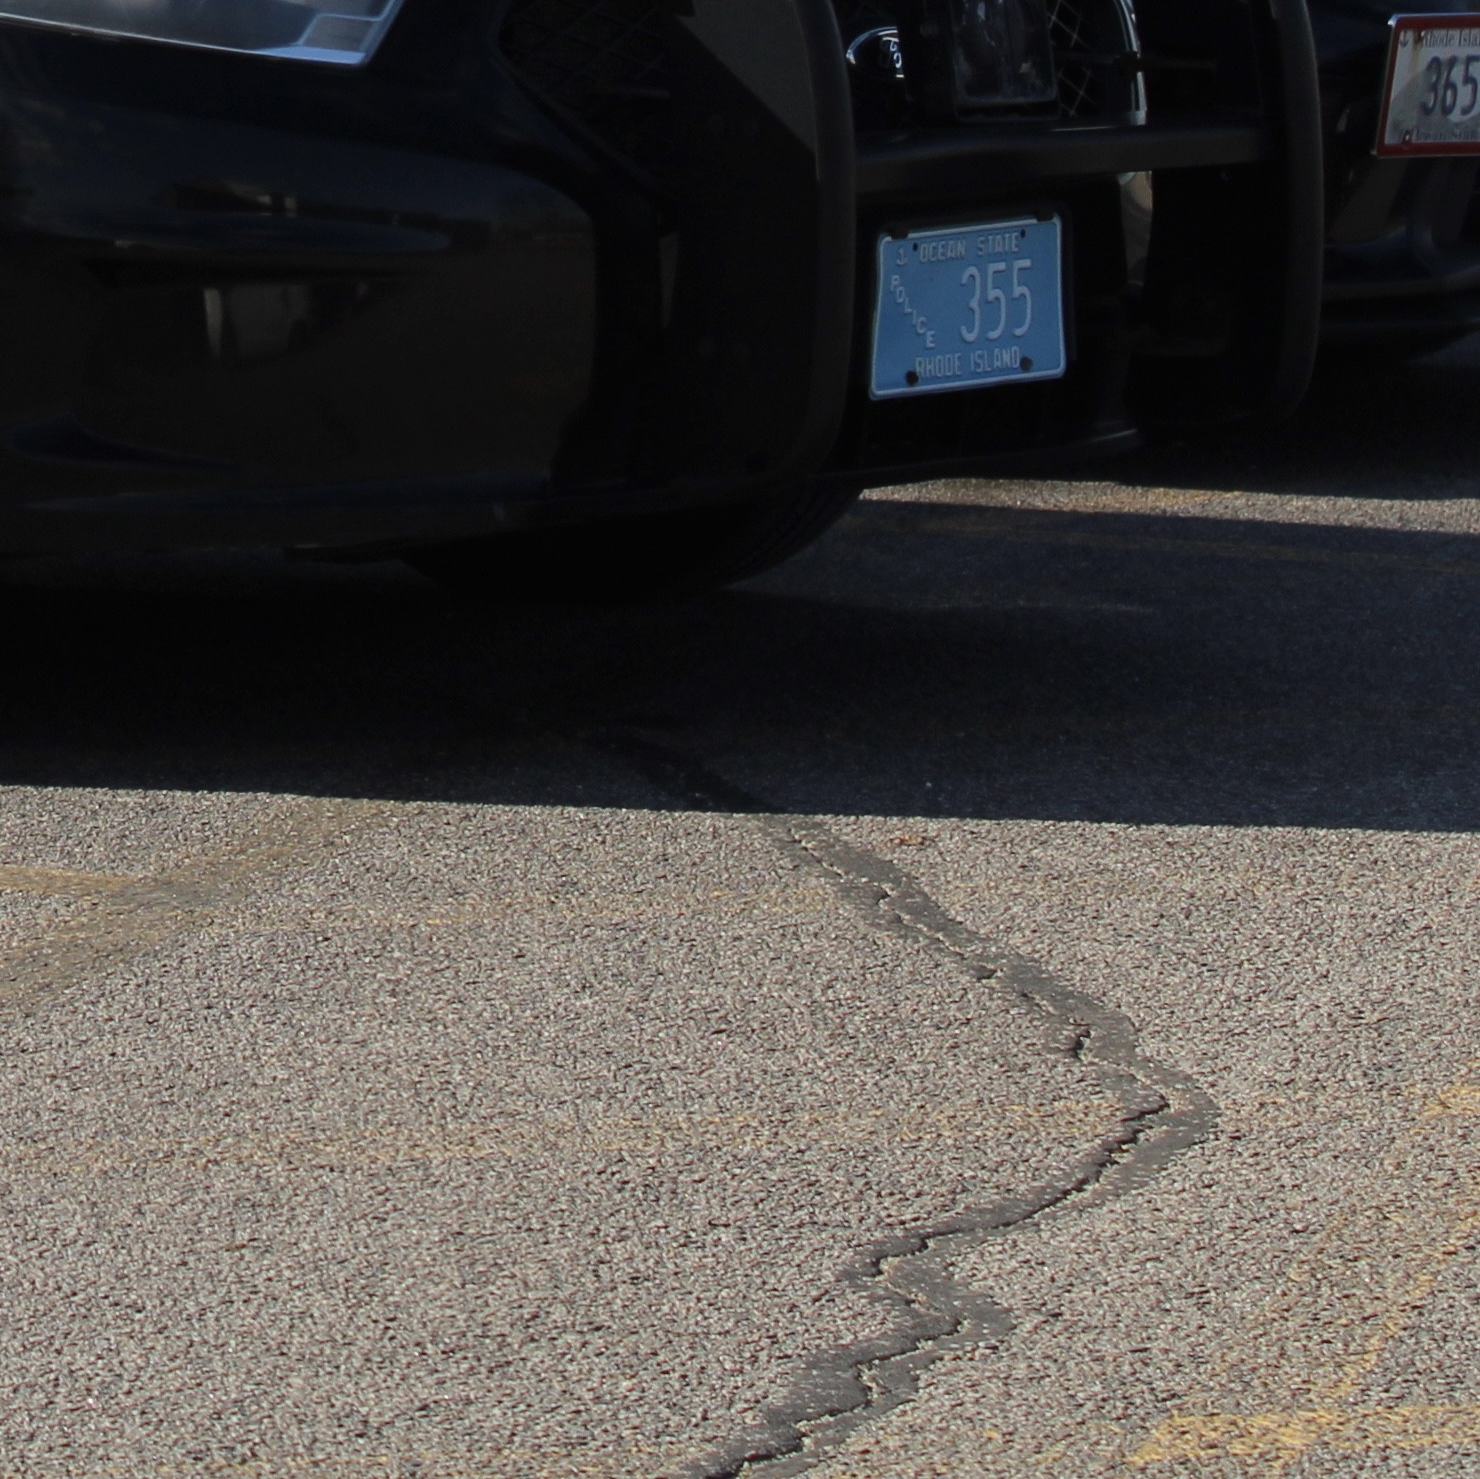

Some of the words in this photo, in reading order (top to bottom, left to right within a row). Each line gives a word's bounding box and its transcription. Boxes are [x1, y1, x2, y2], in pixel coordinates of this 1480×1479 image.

[919, 240, 966, 262] OCEAN
[977, 232, 1020, 255] STATE
[891, 275, 936, 349] POLICE
[960, 258, 1032, 344] 355
[915, 352, 962, 378] RHODE
[970, 346, 1020, 372] ISLAND
